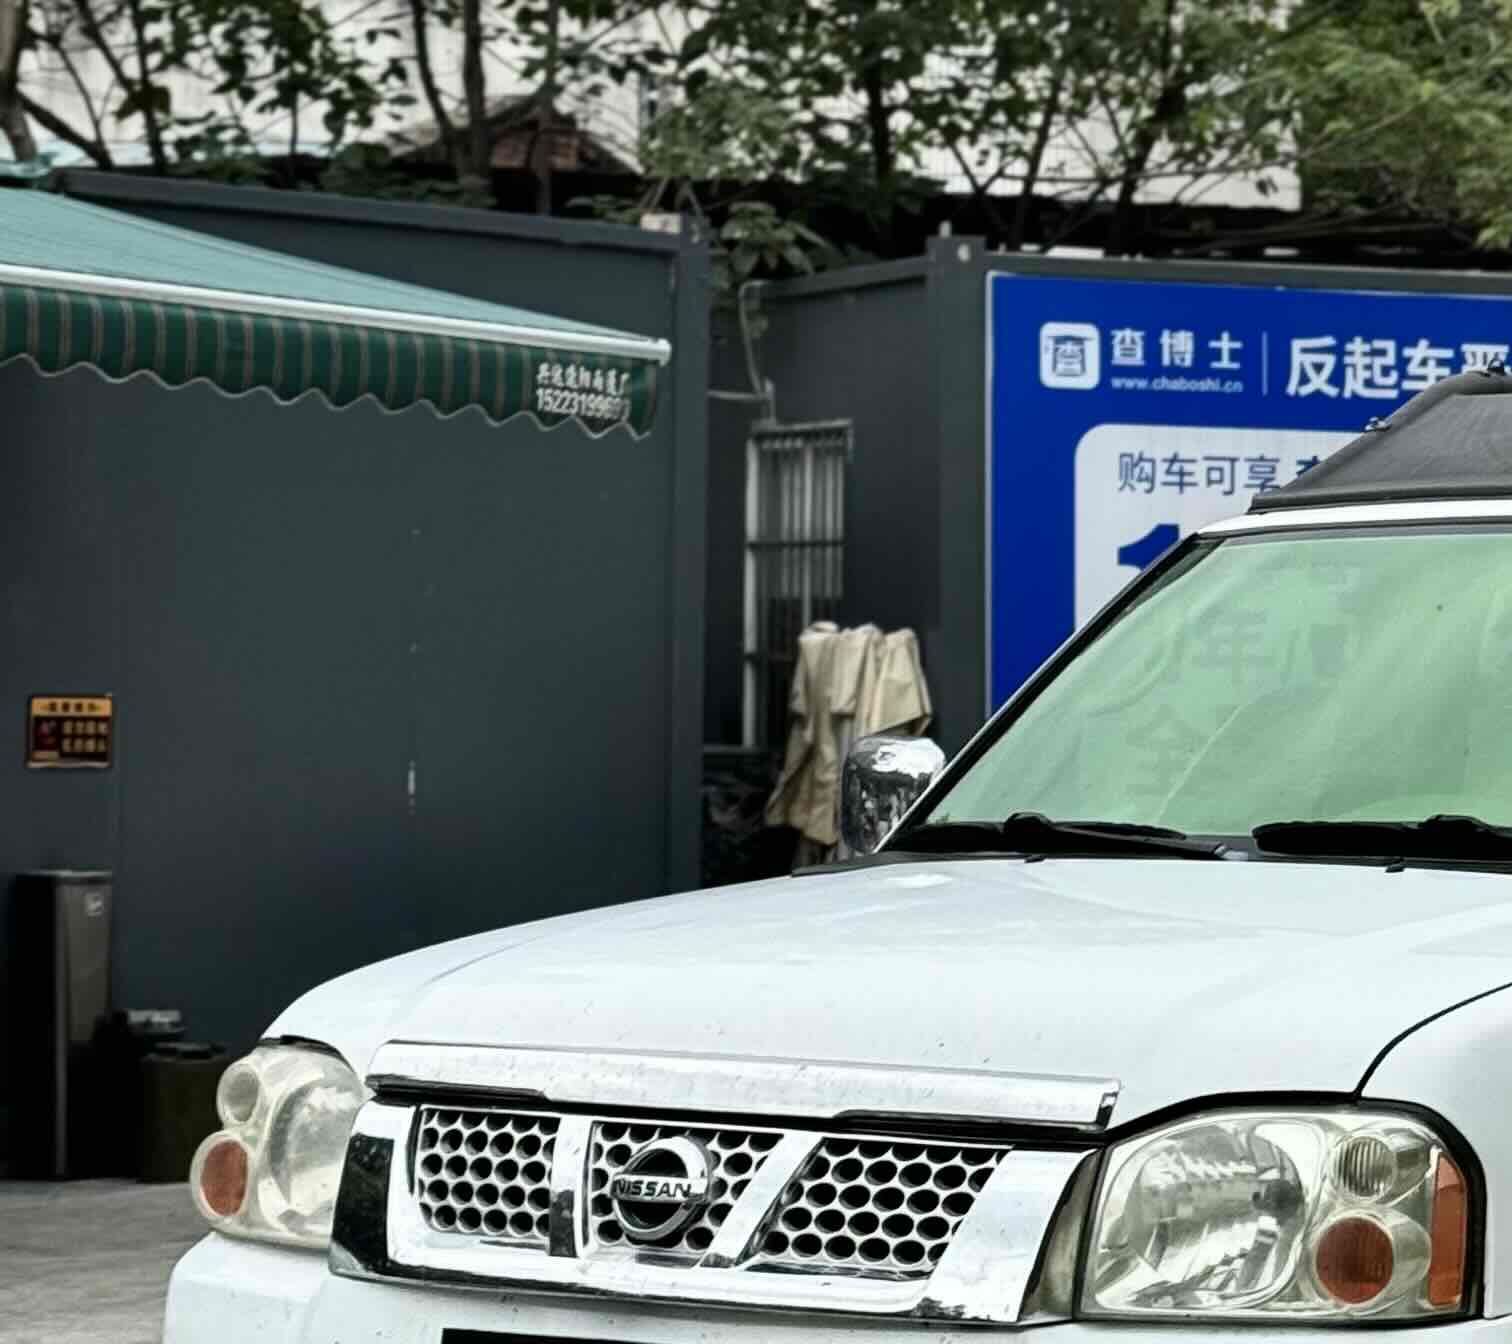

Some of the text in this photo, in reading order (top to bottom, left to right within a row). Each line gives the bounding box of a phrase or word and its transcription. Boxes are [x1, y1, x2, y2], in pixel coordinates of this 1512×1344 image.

[1110, 376, 1244, 394] www.chaboshi.cn
[1116, 451, 1282, 496] 购车可享
[612, 1177, 692, 1199] NISSAN
